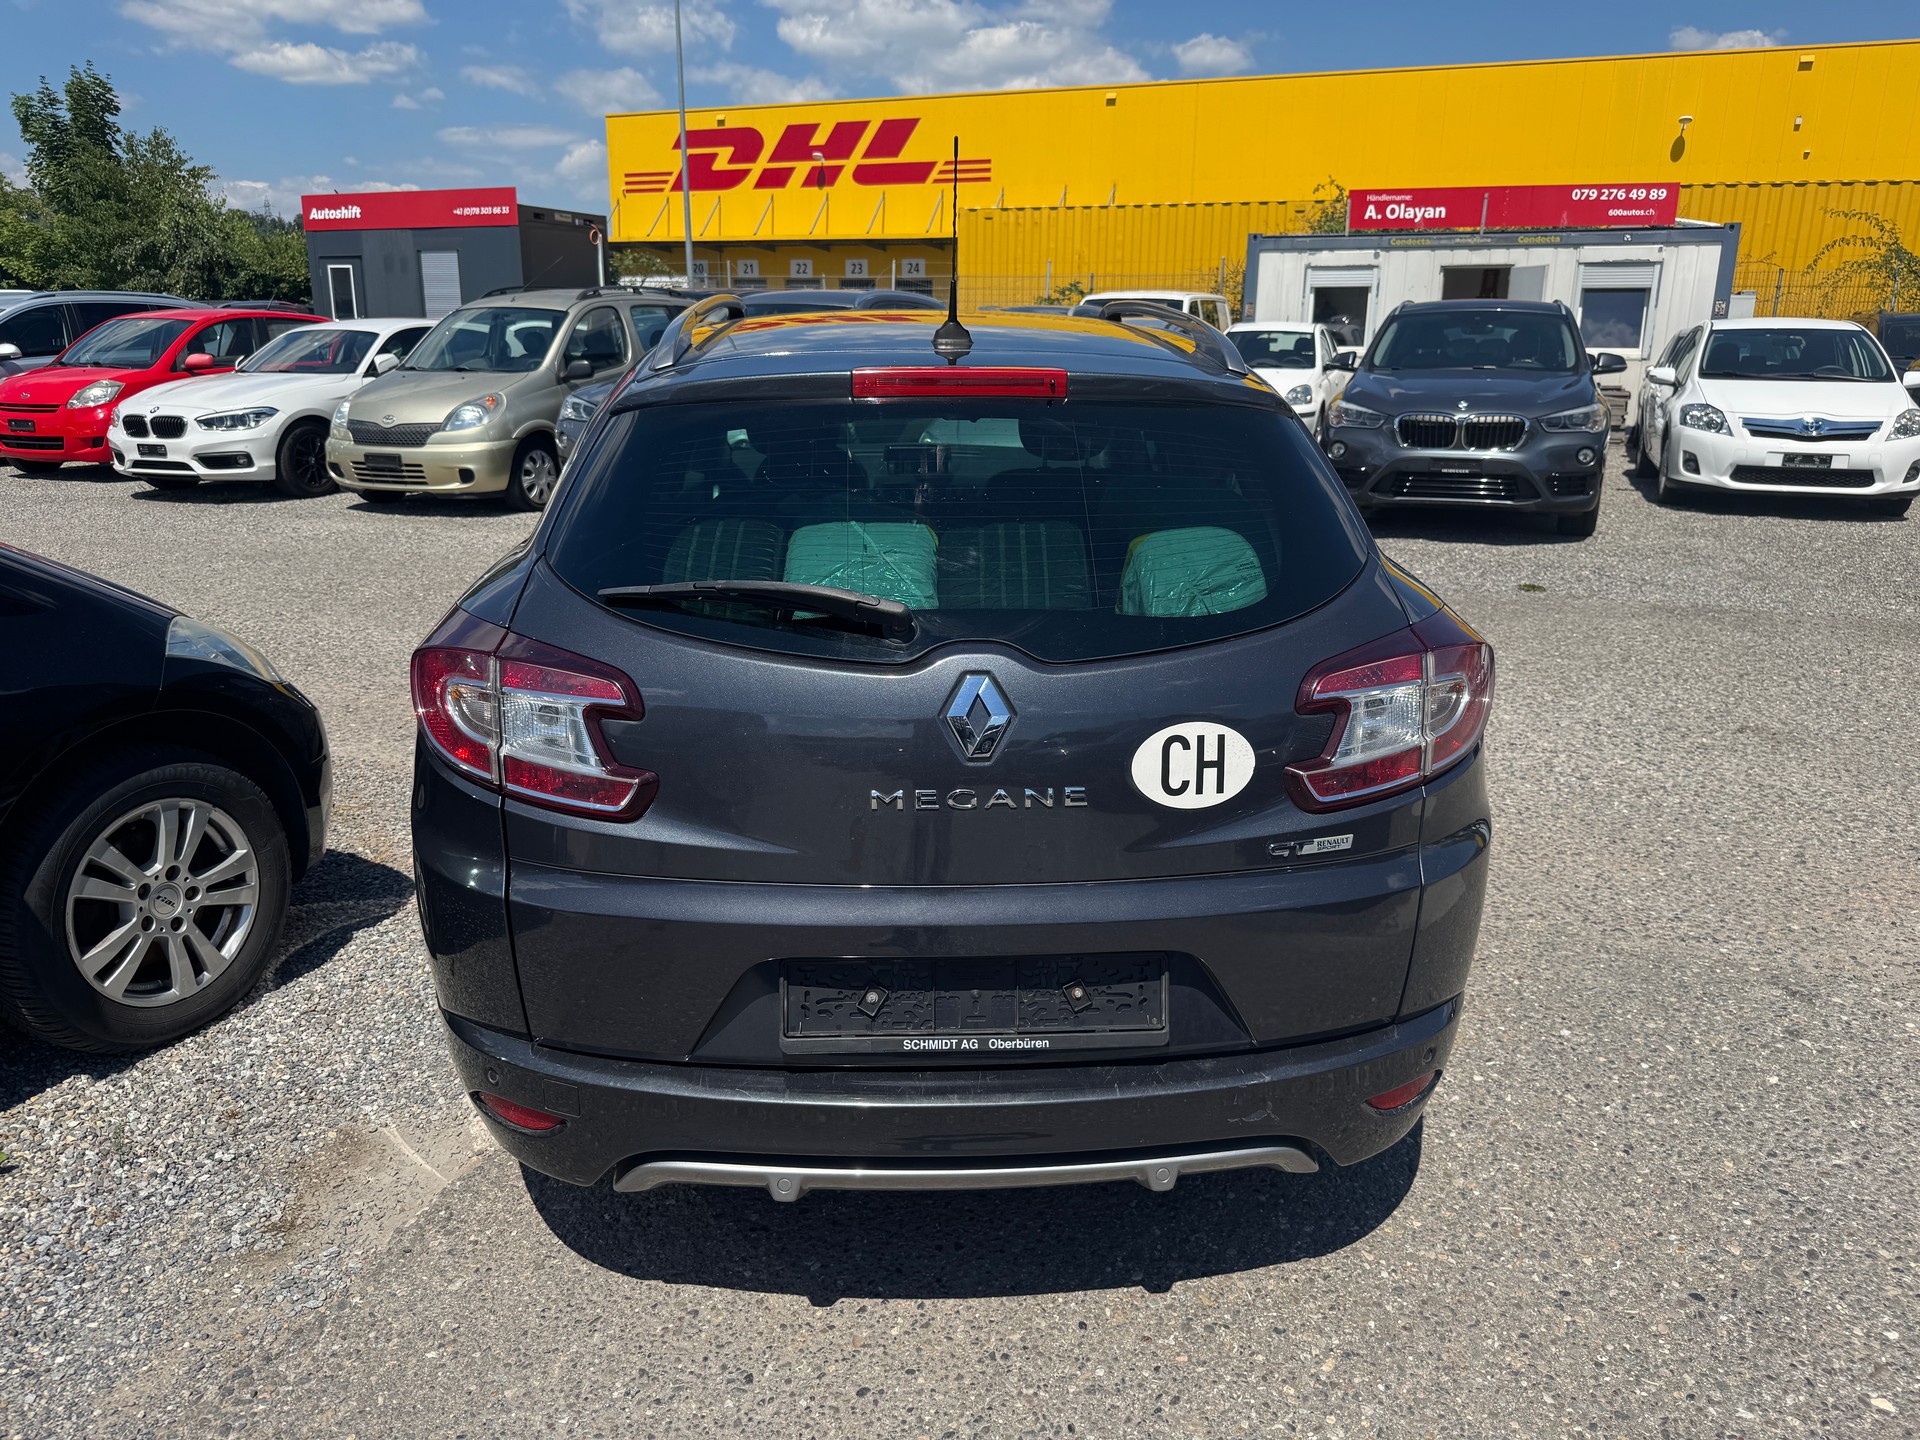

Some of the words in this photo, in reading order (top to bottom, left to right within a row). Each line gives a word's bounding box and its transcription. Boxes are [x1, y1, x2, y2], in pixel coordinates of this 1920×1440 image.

[669, 117, 938, 193] DHL
[1366, 193, 1413, 202] Händlername:
[1571, 188, 1598, 201] 079
[1599, 188, 1626, 201] 276
[1628, 188, 1647, 200] 49
[1648, 188, 1668, 200] 89
[309, 205, 362, 220] Autoshift
[1364, 204, 1382, 220] A.
[1385, 203, 1446, 223] Olayan
[1608, 208, 1655, 217] 600autos.ch
[1517, 235, 1561, 244] Condecta
[693, 263, 705, 274] 20
[743, 263, 754, 275] 21
[796, 263, 808, 275] 22
[851, 263, 863, 275] 23
[907, 262, 920, 274] 24
[1161, 734, 1226, 796] CH
[870, 786, 1088, 811] MEGANE
[1268, 840, 1314, 857] GT
[1316, 837, 1350, 848] RENAULT
[1316, 844, 1341, 852] SPORT
[903, 1039, 958, 1050] SCHMIDT
[960, 1039, 979, 1050] AG
[988, 1038, 1050, 1050] Oberbüren
